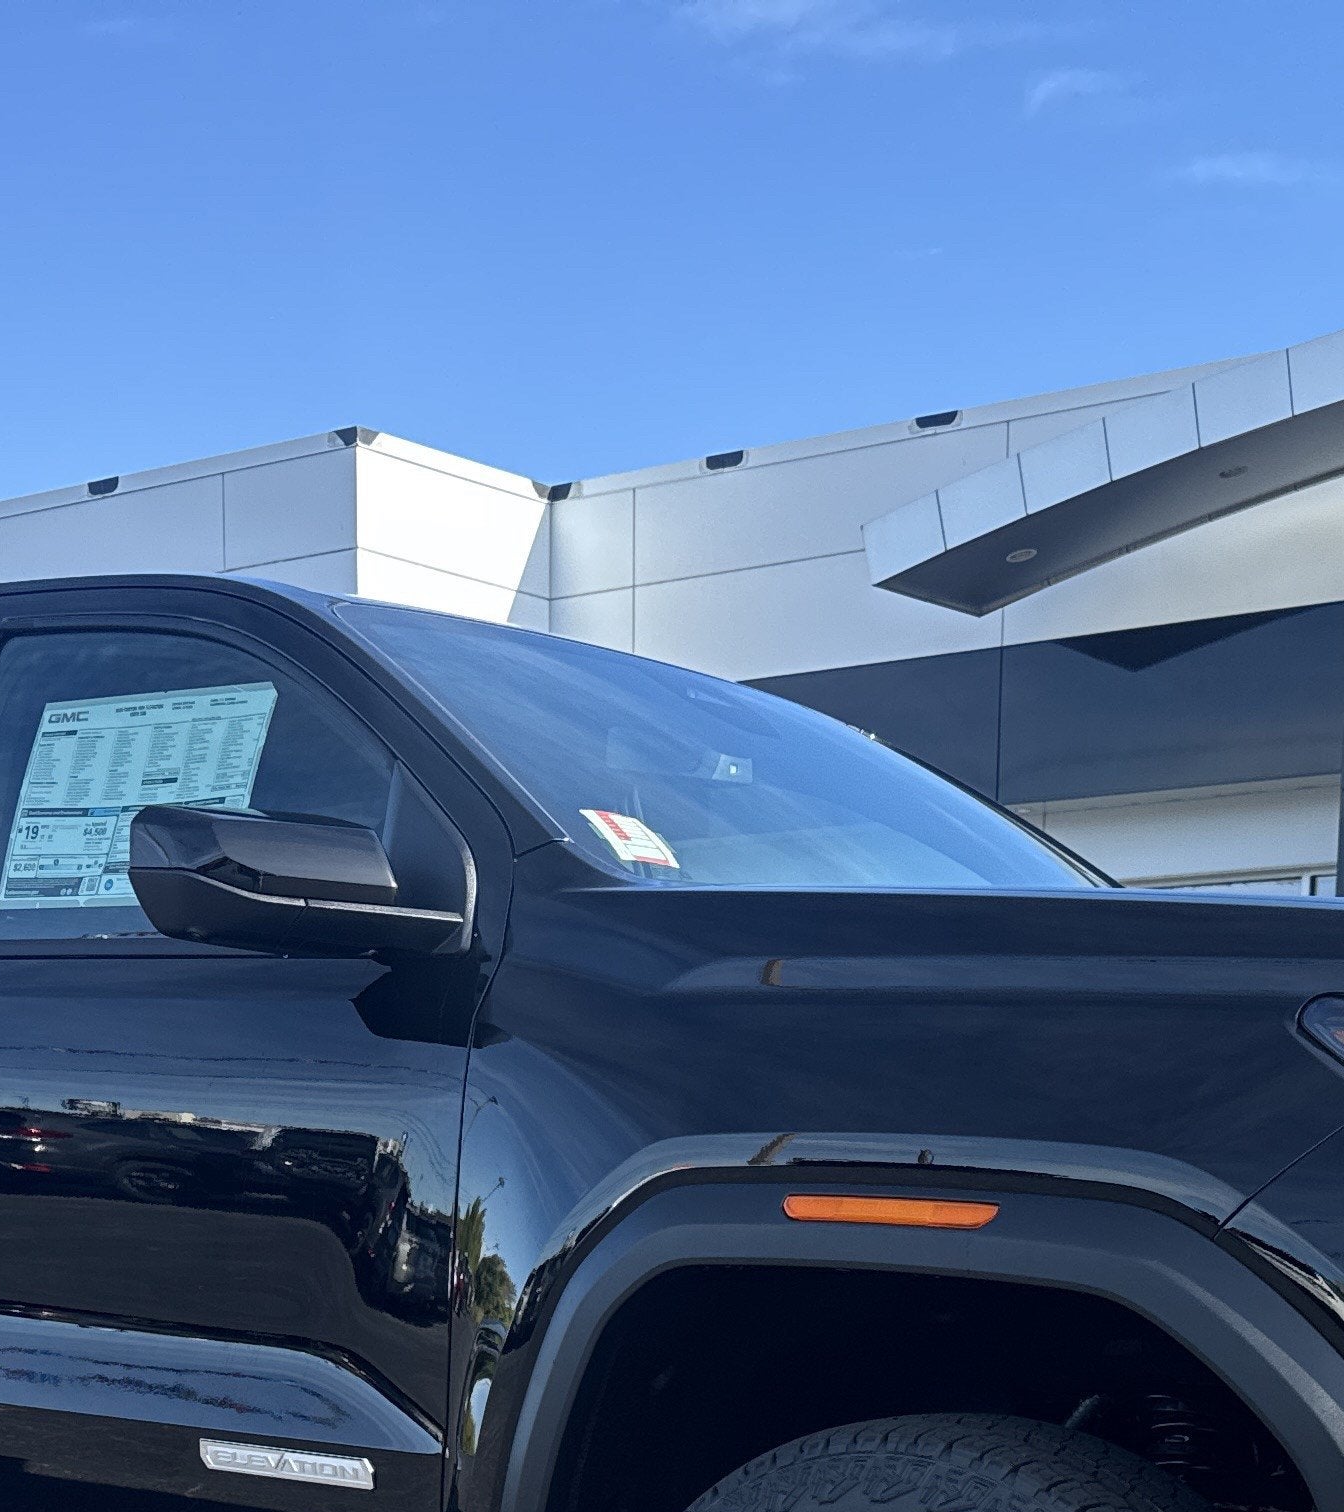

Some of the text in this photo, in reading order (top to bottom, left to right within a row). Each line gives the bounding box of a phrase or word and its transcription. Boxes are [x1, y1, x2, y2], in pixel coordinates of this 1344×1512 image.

[47, 710, 90, 725] GMC
[25, 825, 39, 840] 19
[214, 1450, 360, 1480] ELEVATION
